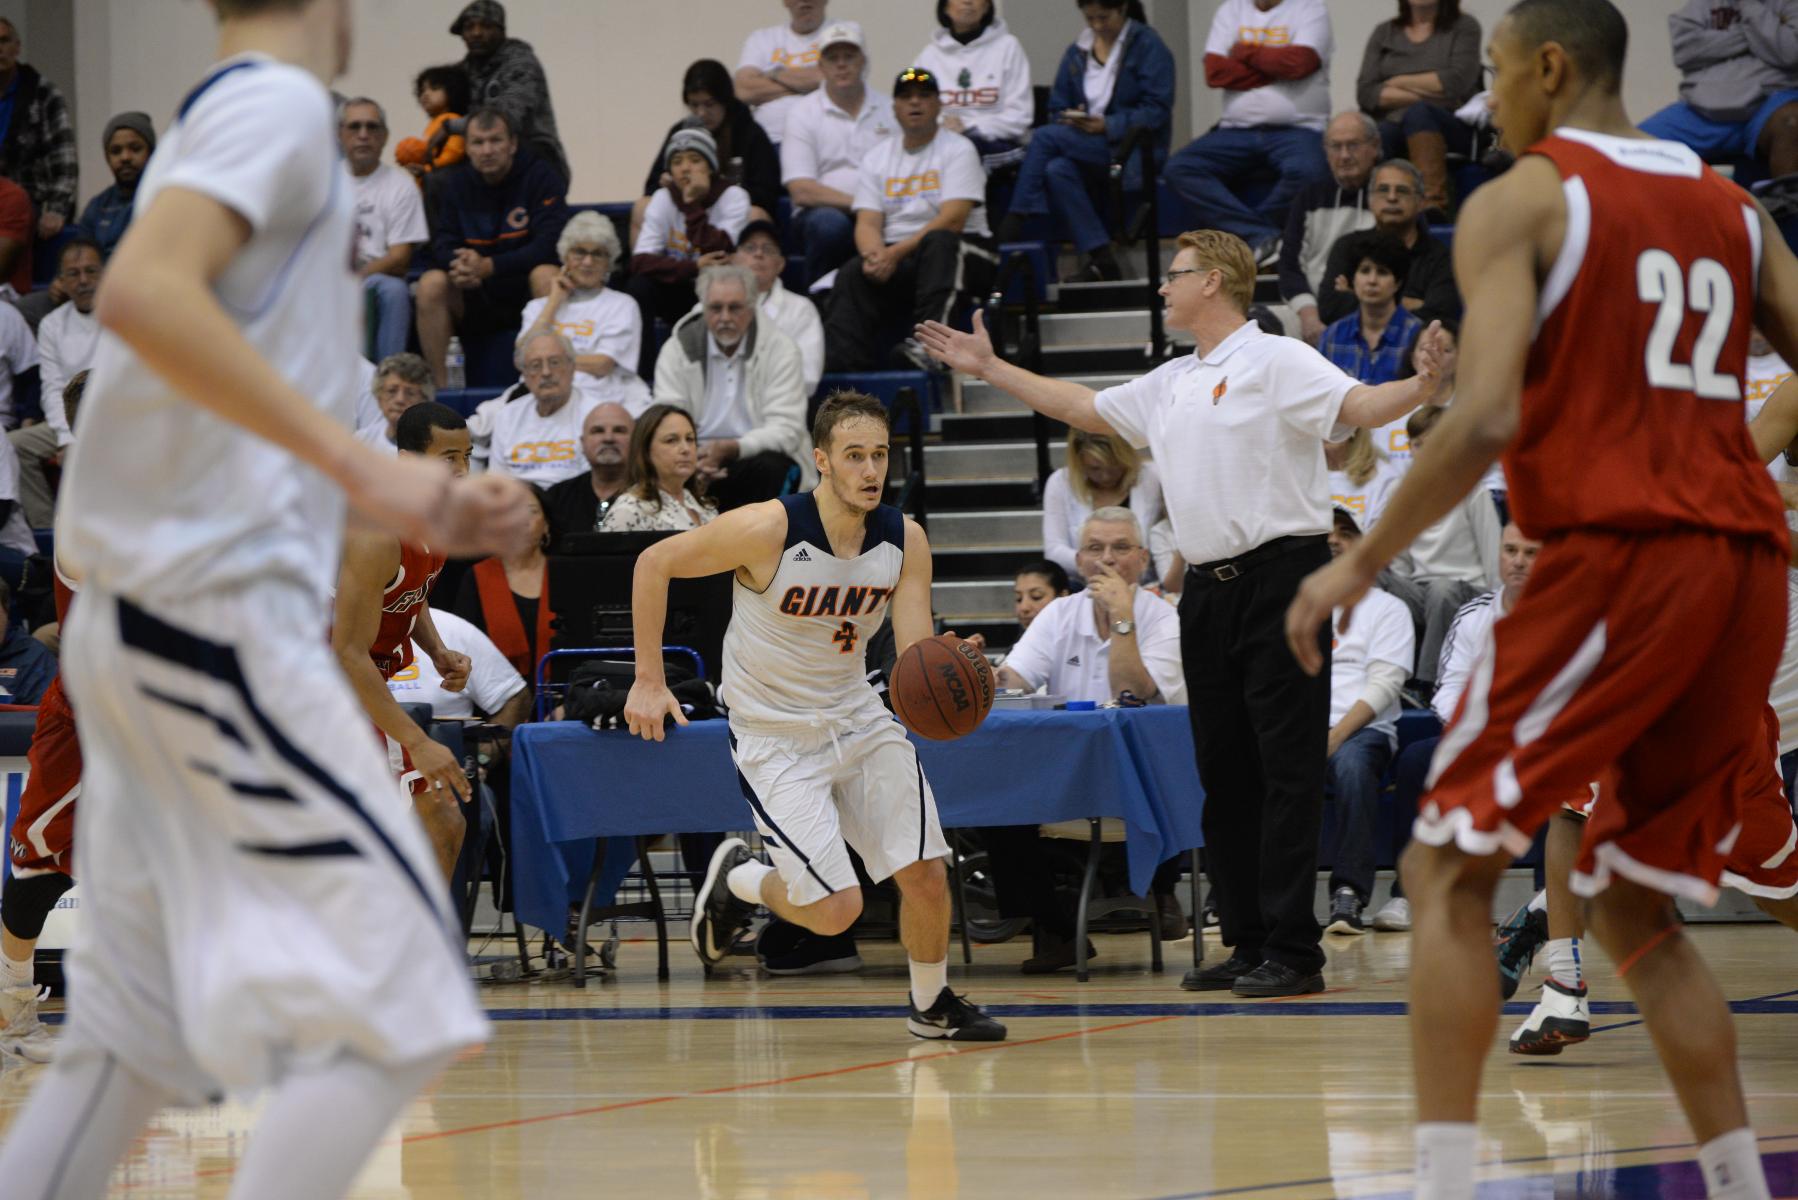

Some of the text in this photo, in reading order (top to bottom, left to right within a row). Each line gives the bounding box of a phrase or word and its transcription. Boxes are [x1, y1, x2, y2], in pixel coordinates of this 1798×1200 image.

[885, 169, 941, 197] COS
[1636, 248, 1742, 401] 22
[511, 440, 577, 463] COS
[831, 620, 859, 655] 4
[938, 663, 970, 714] NCAA
